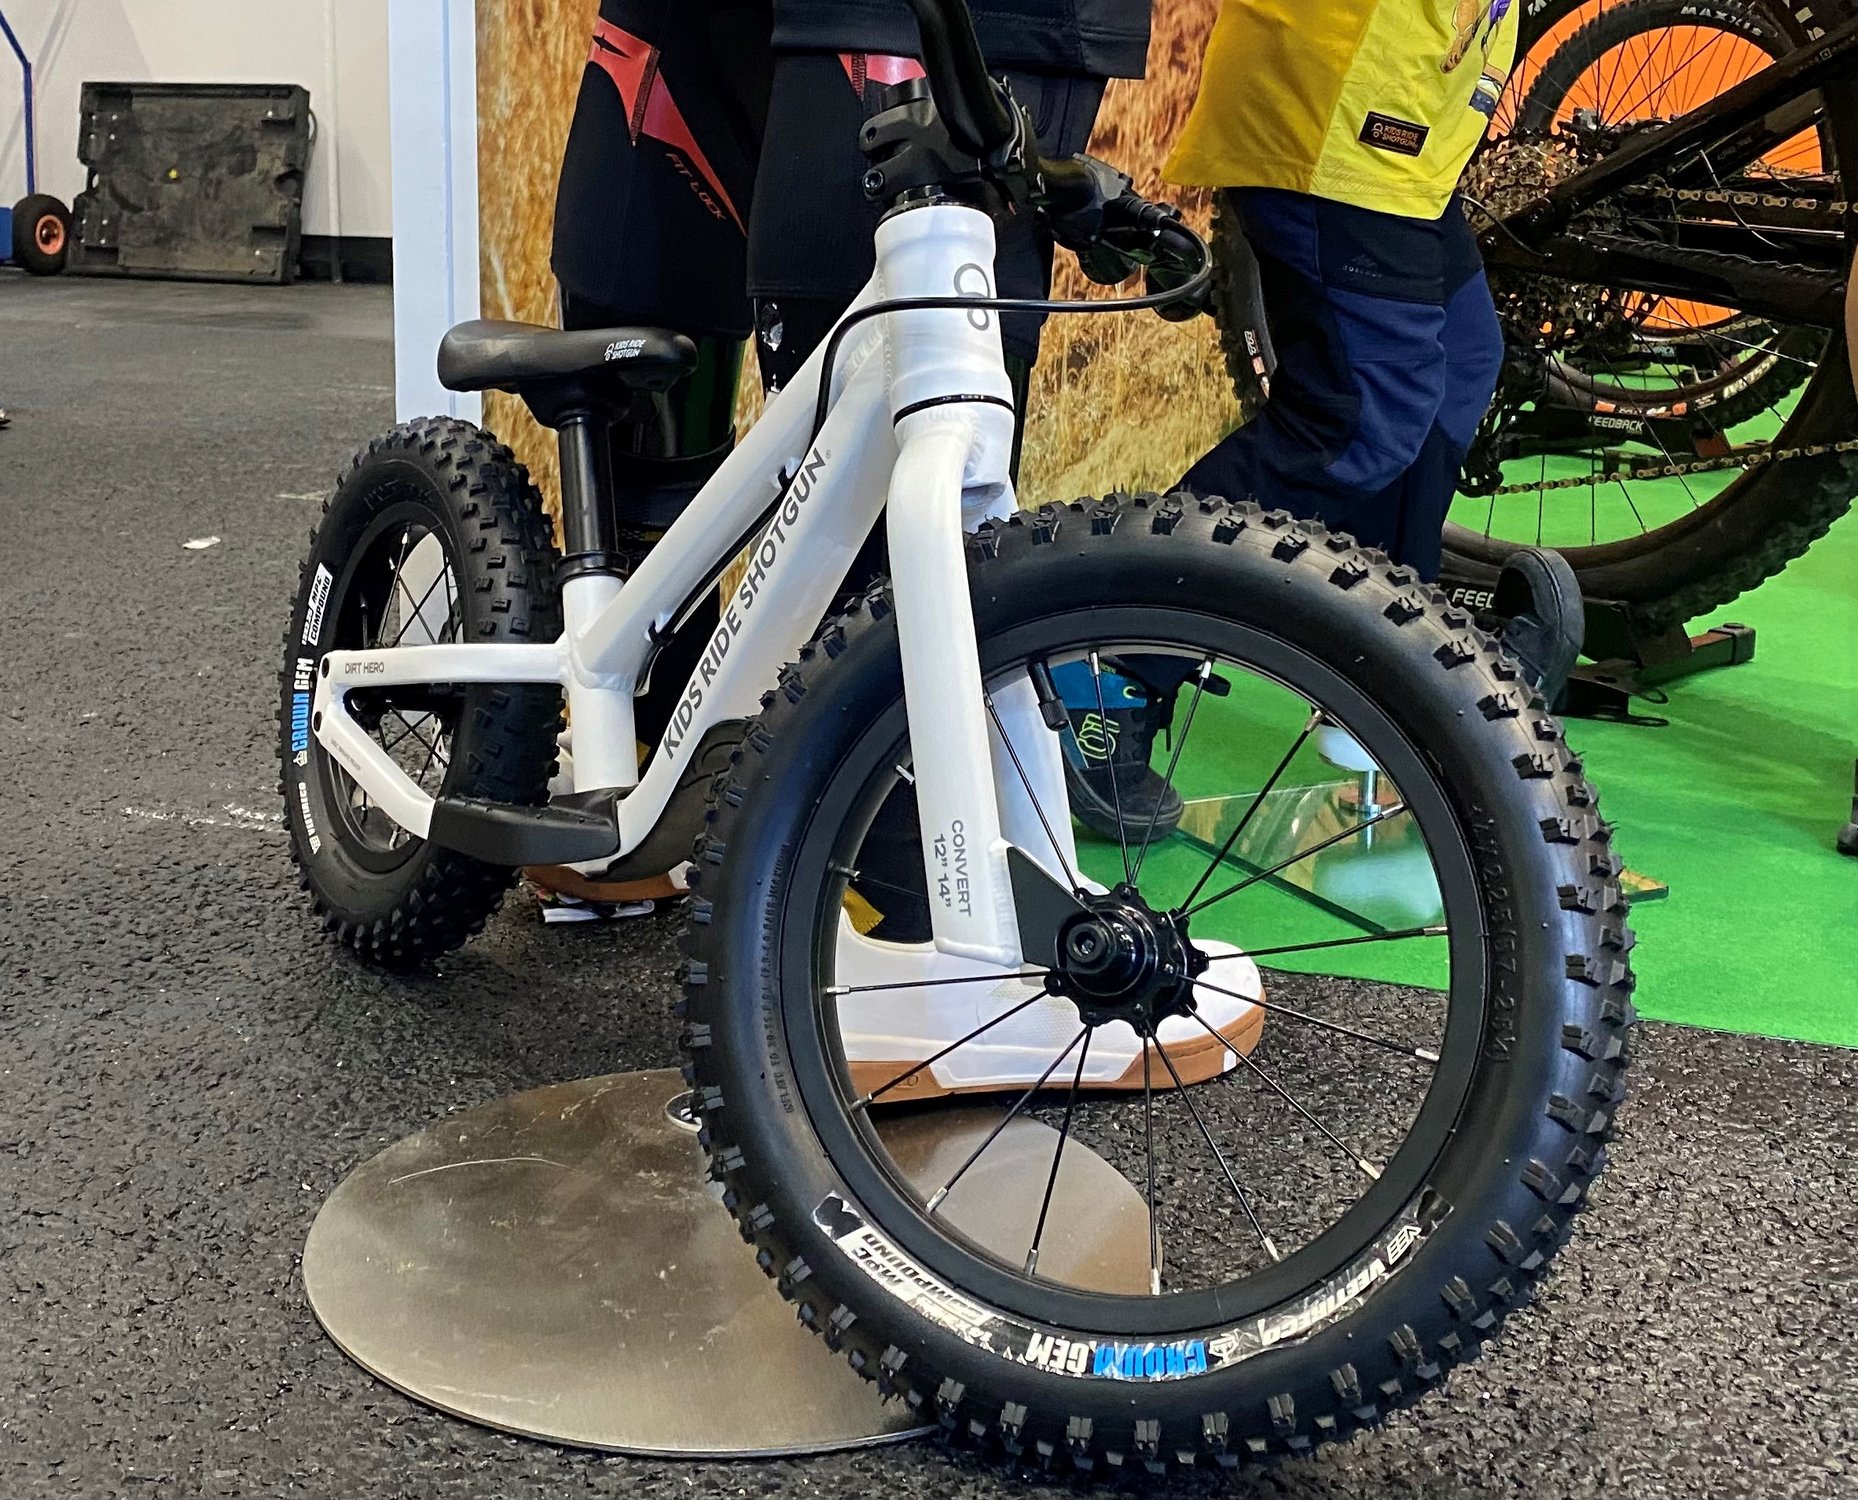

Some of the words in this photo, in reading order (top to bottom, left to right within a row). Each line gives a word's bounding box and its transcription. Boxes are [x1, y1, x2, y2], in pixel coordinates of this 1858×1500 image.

[1383, 125, 1401, 136] KIDS
[310, 575, 331, 642] COMPOUND
[663, 681, 703, 760] KIDS
[699, 605, 743, 688] RIDE
[739, 447, 826, 610] SHOTGUN
[293, 657, 315, 691] GEM
[344, 662, 362, 675] DIRT
[363, 661, 385, 674] HERO
[291, 692, 310, 752] CROWN
[951, 819, 972, 918] CONVERT
[1025, 1332, 1090, 1374] GEM
[1093, 1339, 1208, 1378] CROWN
